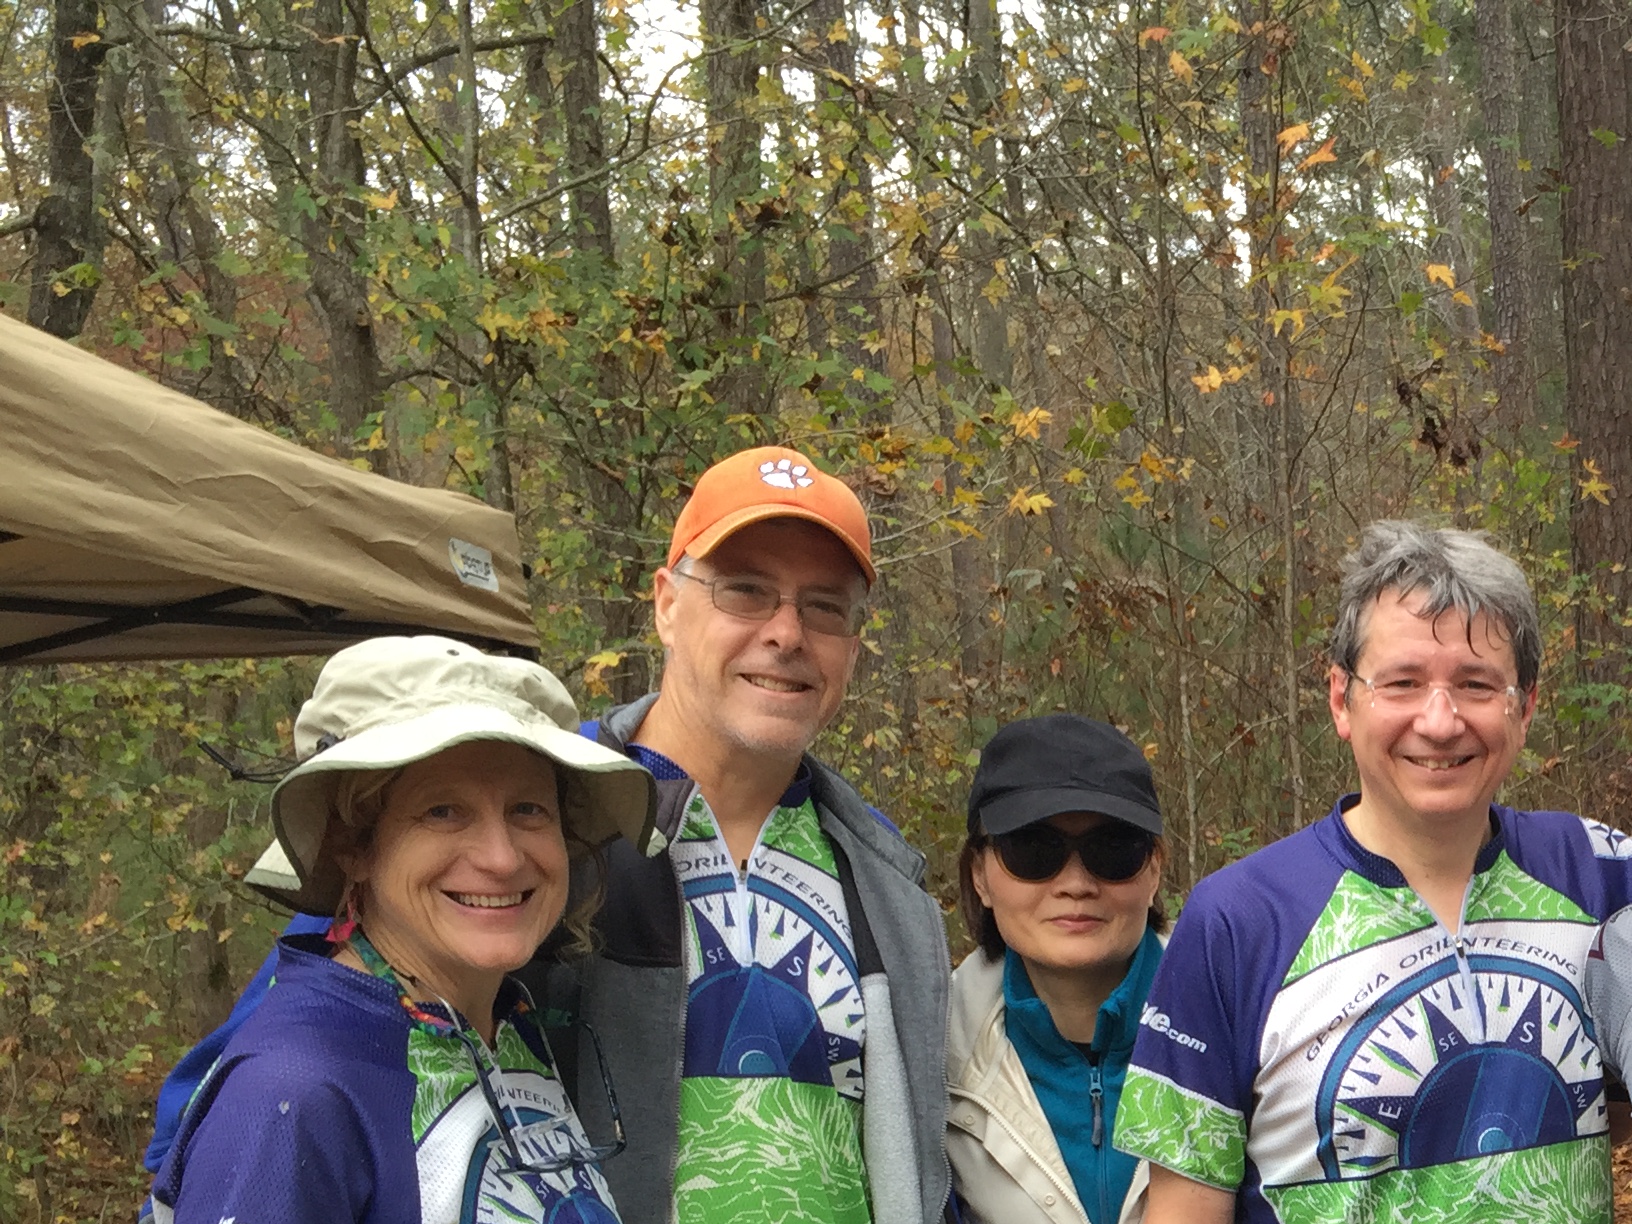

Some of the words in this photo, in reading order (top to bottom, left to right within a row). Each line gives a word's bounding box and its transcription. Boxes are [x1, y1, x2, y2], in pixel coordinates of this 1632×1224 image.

[786, 955, 805, 977] S
[1305, 972, 1391, 1063] GEORGIA
[1438, 1031, 1460, 1052] SE
[1519, 1021, 1536, 1044] S
[1572, 1083, 1588, 1109] SW
[1378, 1102, 1402, 1120] E
